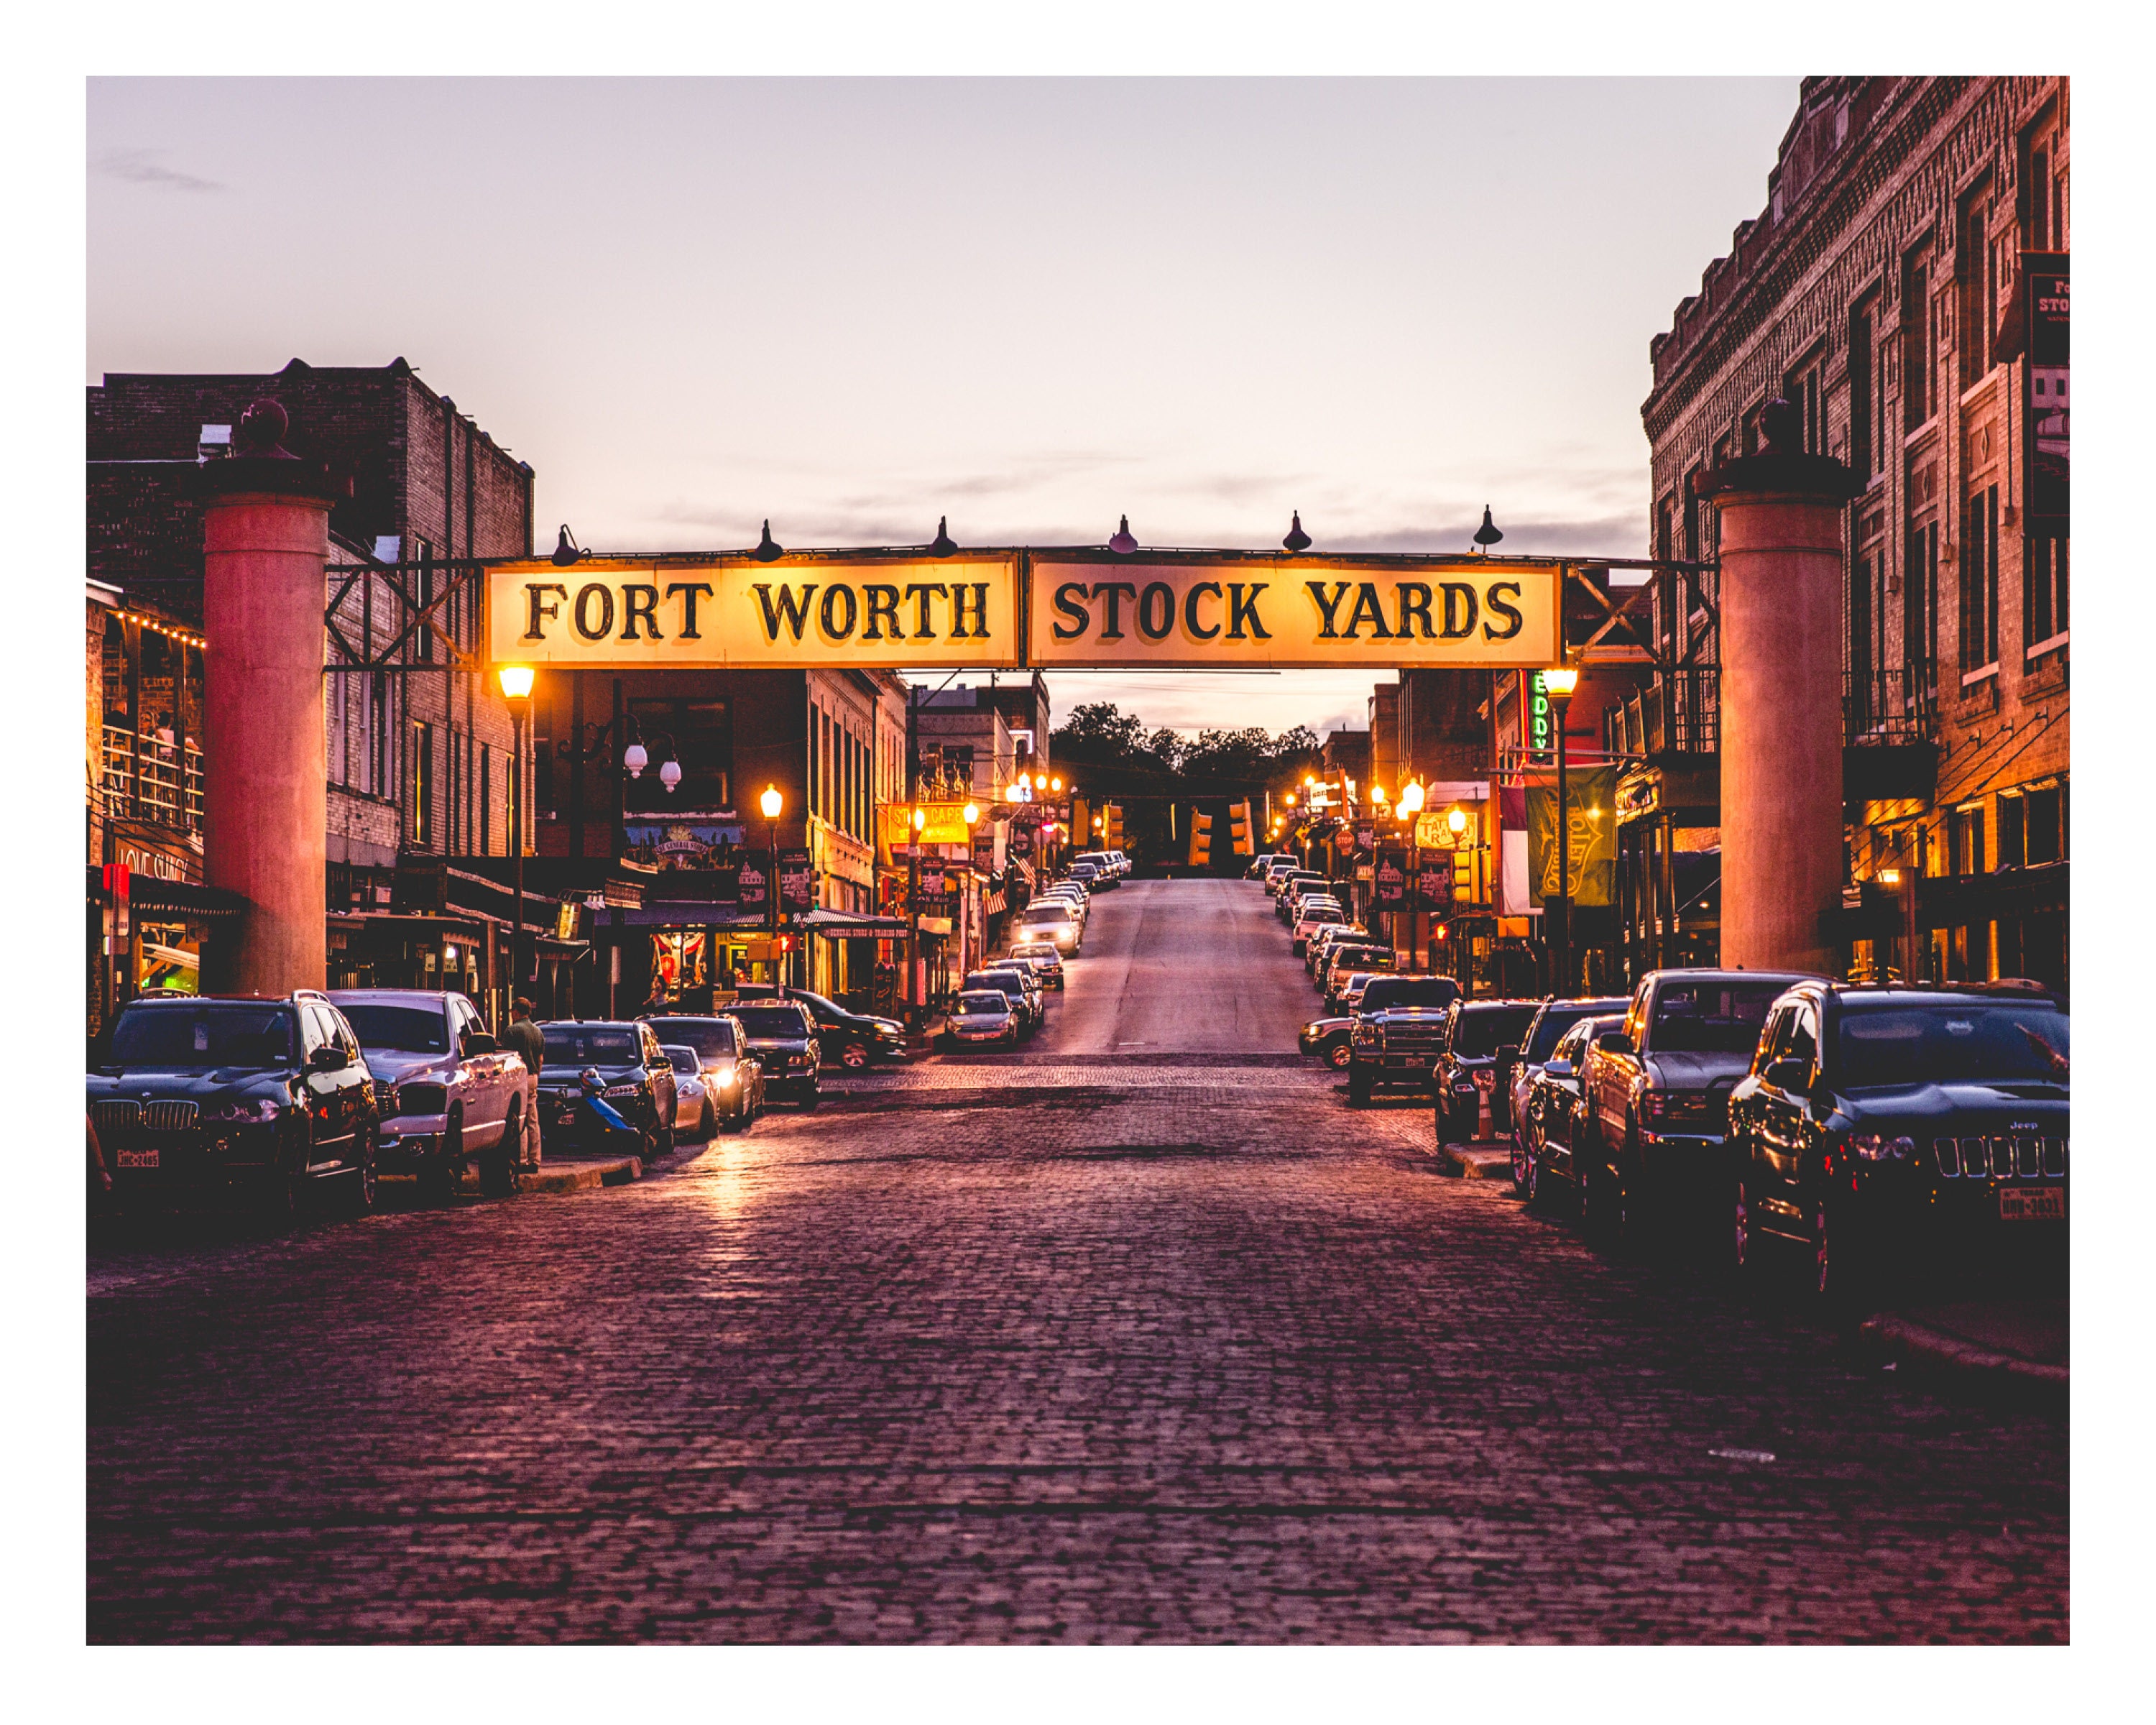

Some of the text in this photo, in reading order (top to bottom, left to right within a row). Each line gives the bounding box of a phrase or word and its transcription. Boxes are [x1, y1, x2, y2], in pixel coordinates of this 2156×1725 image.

[524, 581, 1523, 640] FORT WORTH STOCK YARDS
[2010, 1121, 2038, 1130] Jeep
